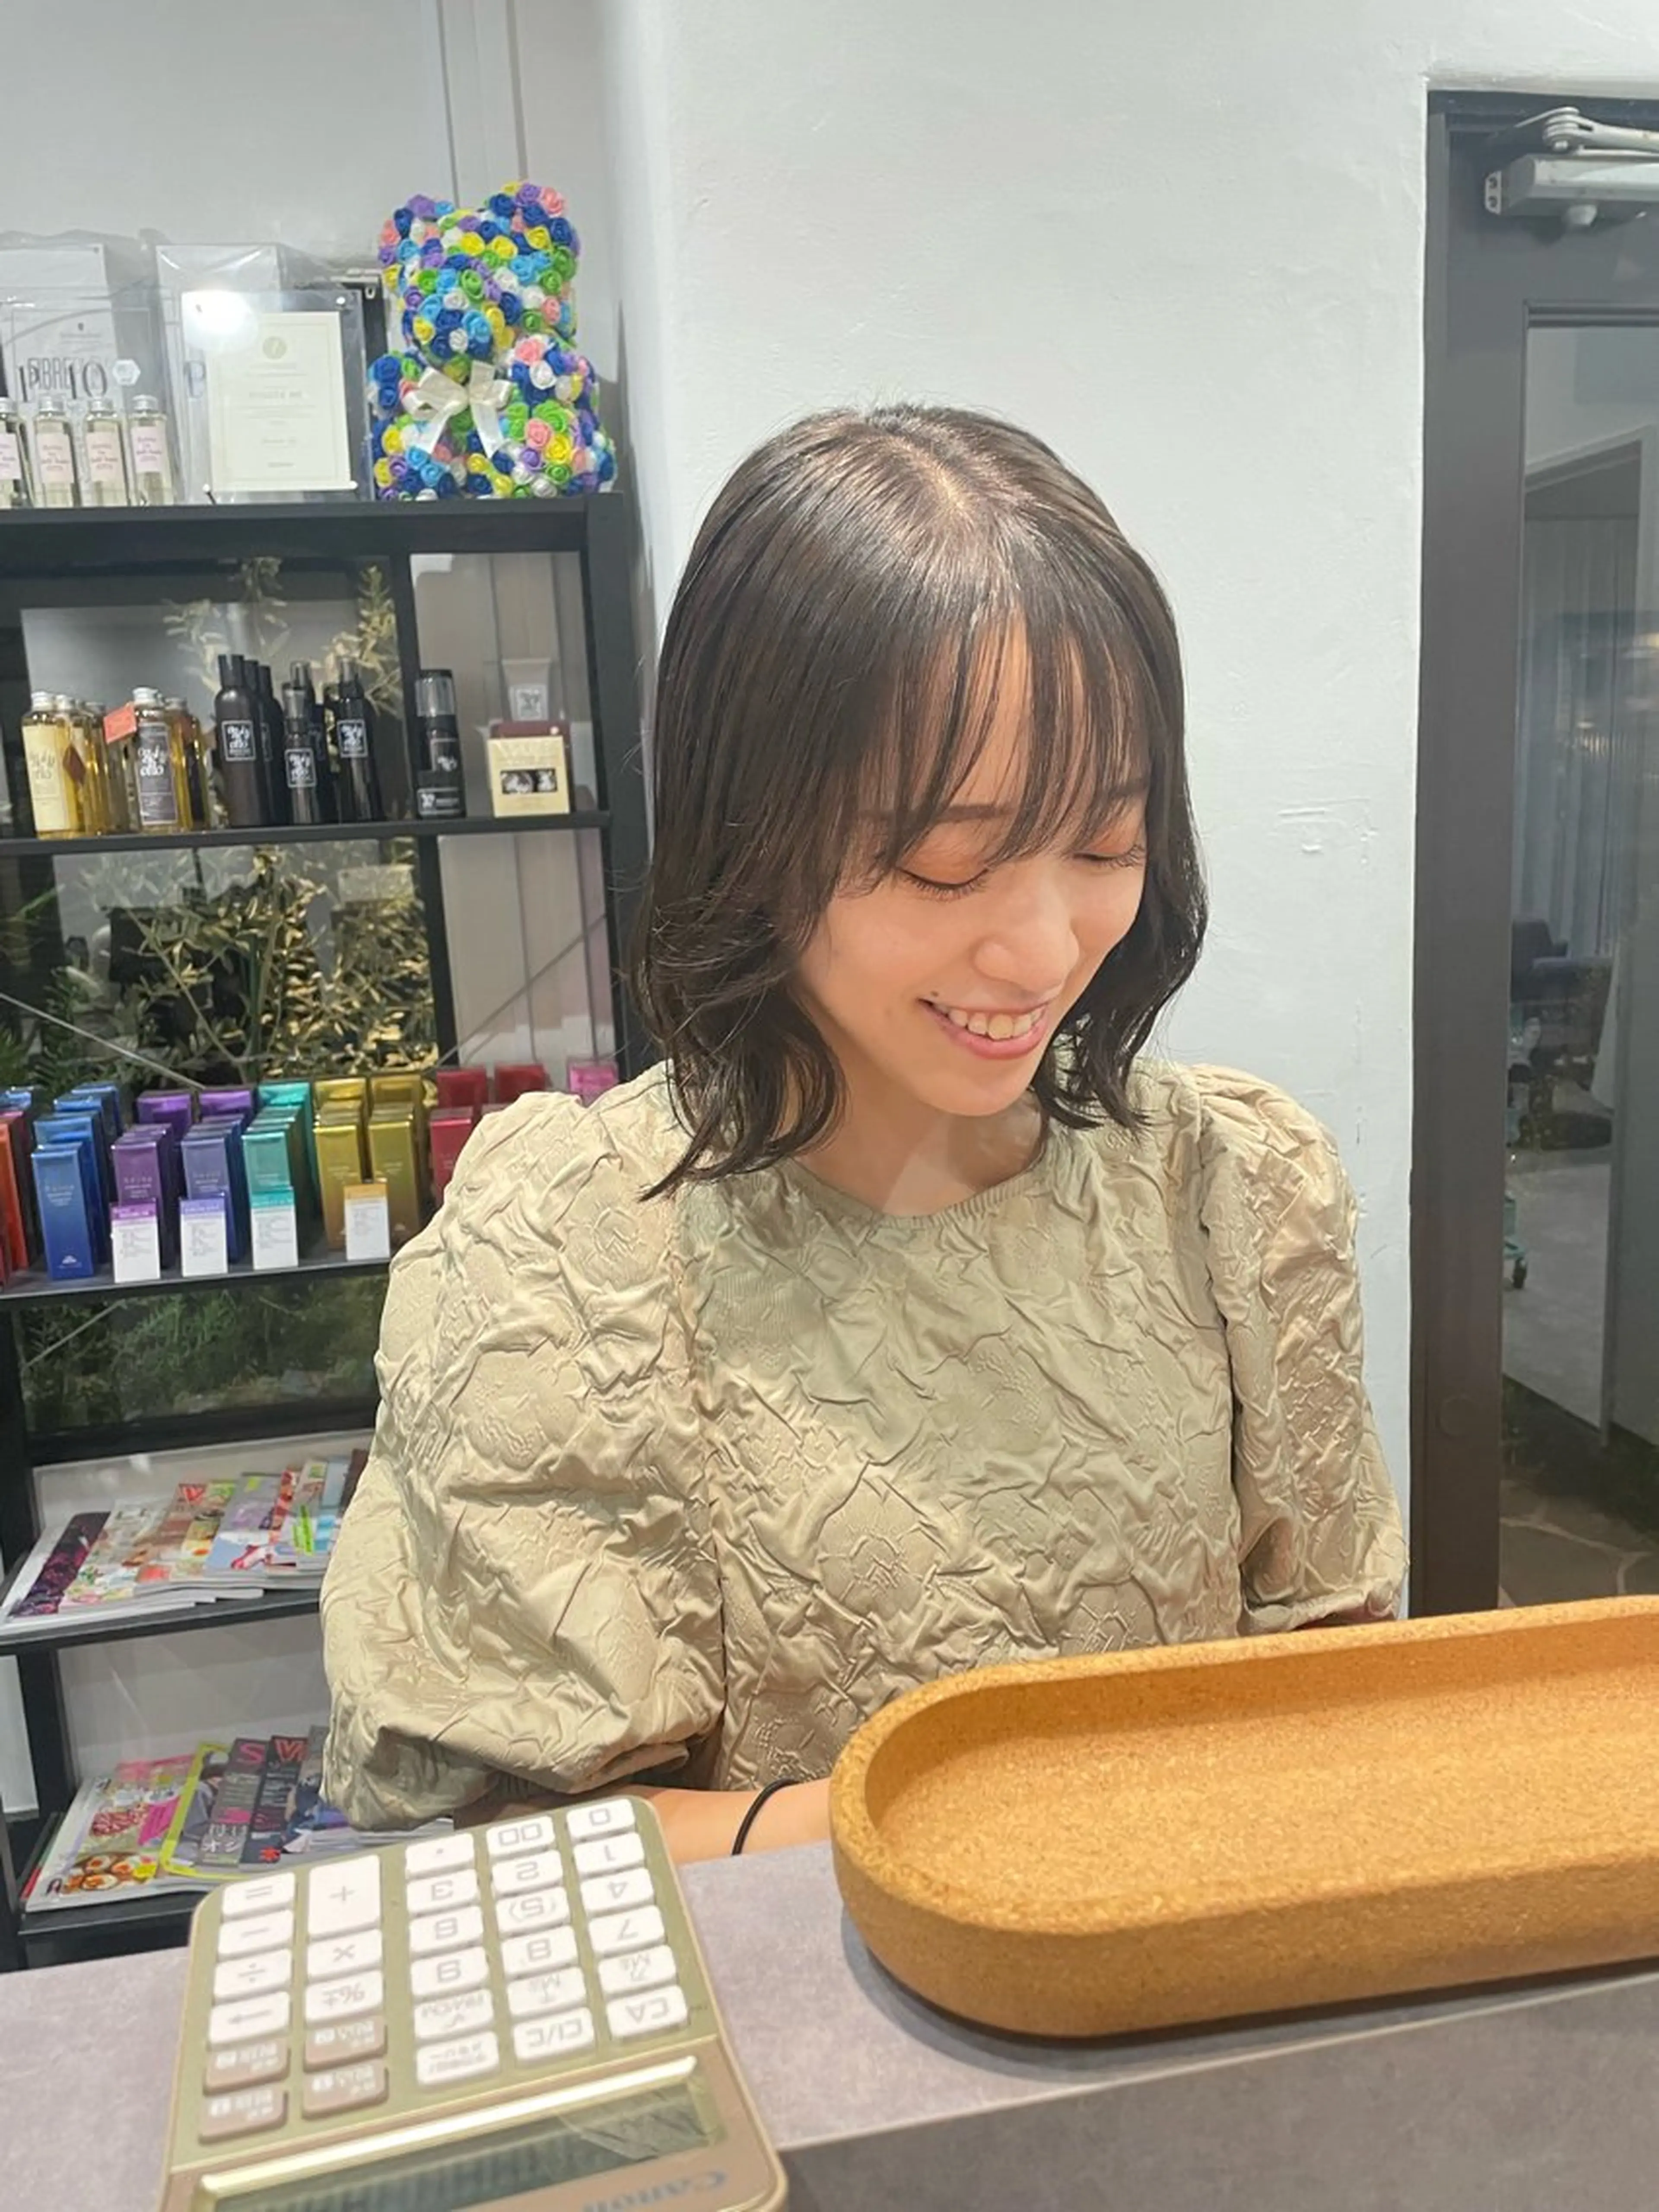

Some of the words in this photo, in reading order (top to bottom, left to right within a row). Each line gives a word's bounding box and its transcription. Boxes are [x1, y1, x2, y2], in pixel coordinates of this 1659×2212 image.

[516, 1861, 540, 1881] 2
[431, 1879, 454, 1900] 3
[607, 1881, 628, 1899] 4
[617, 1918, 639, 1940] 7
[527, 1938, 551, 1961] 8
[436, 1959, 462, 1983] 9
[625, 1997, 670, 2024] CA
